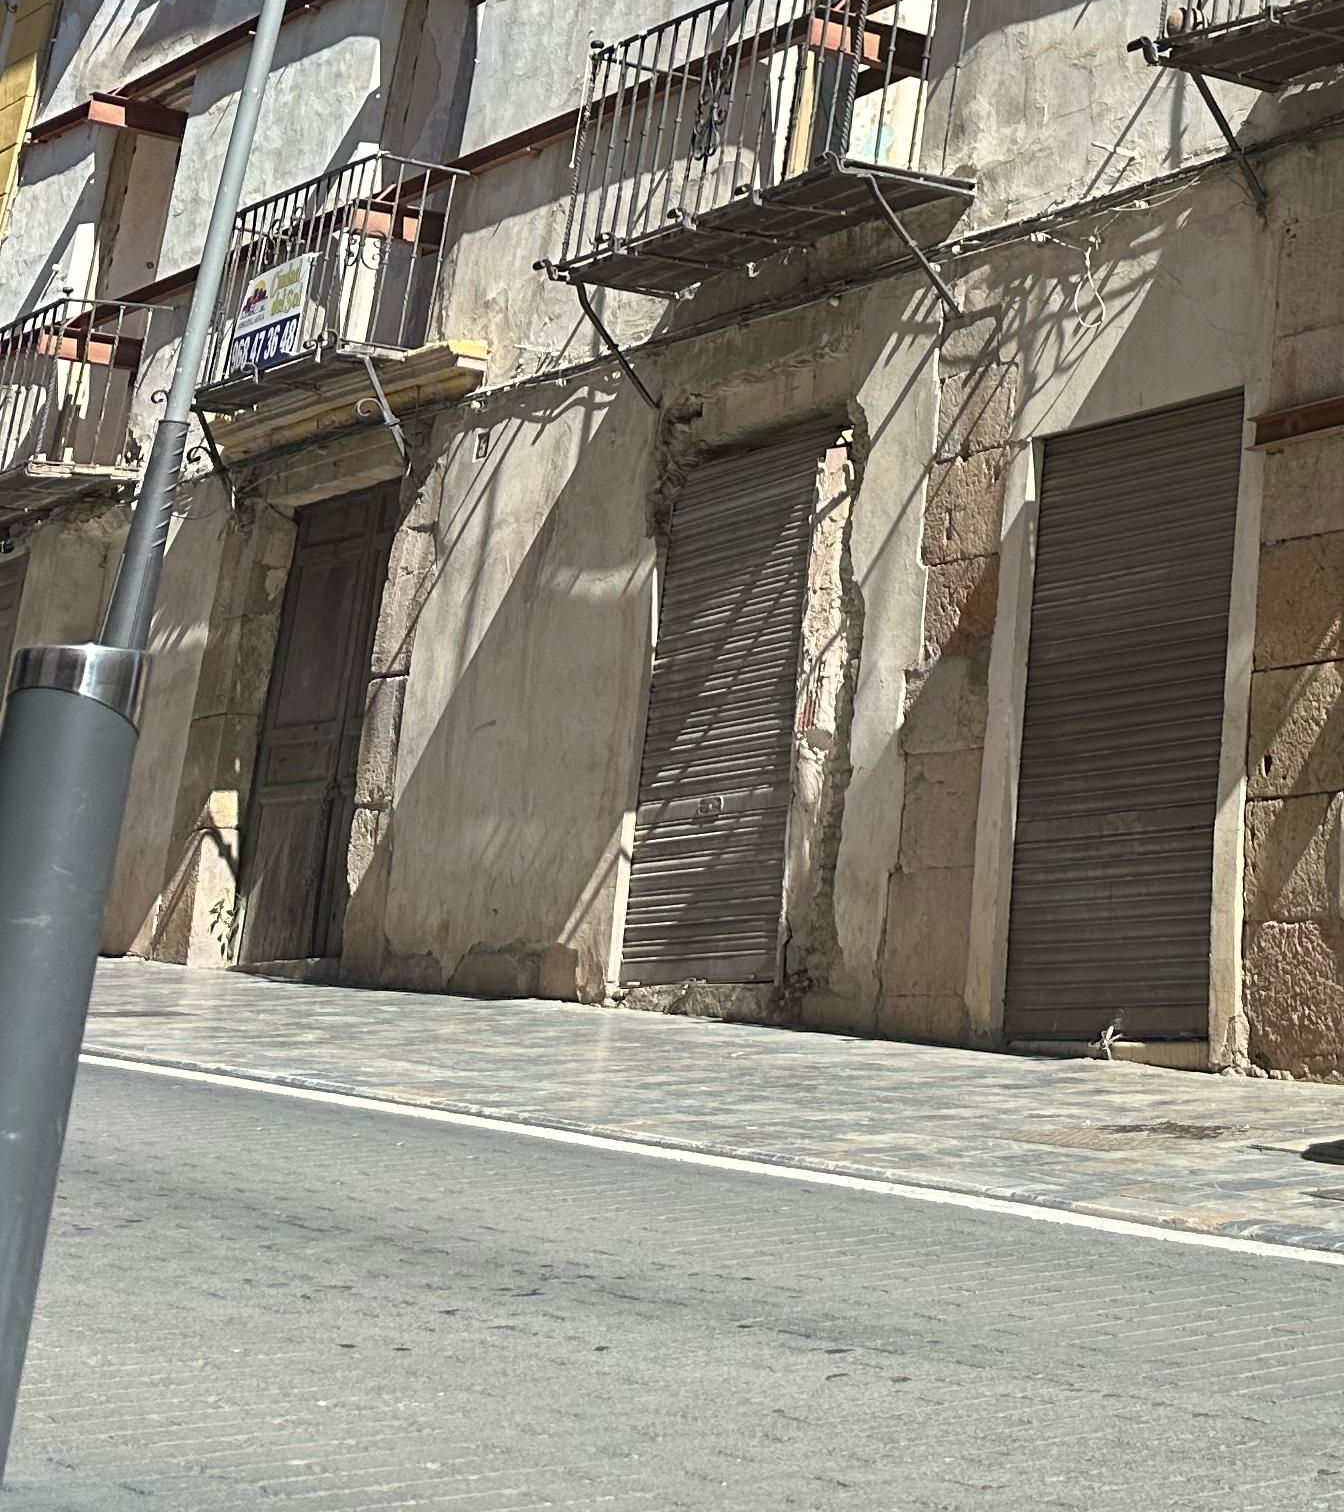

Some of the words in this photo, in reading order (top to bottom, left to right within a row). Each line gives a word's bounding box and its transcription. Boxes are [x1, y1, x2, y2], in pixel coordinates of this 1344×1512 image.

[249, 329, 267, 364] 47
[264, 324, 280, 359] 36
[279, 318, 297, 354] 48
